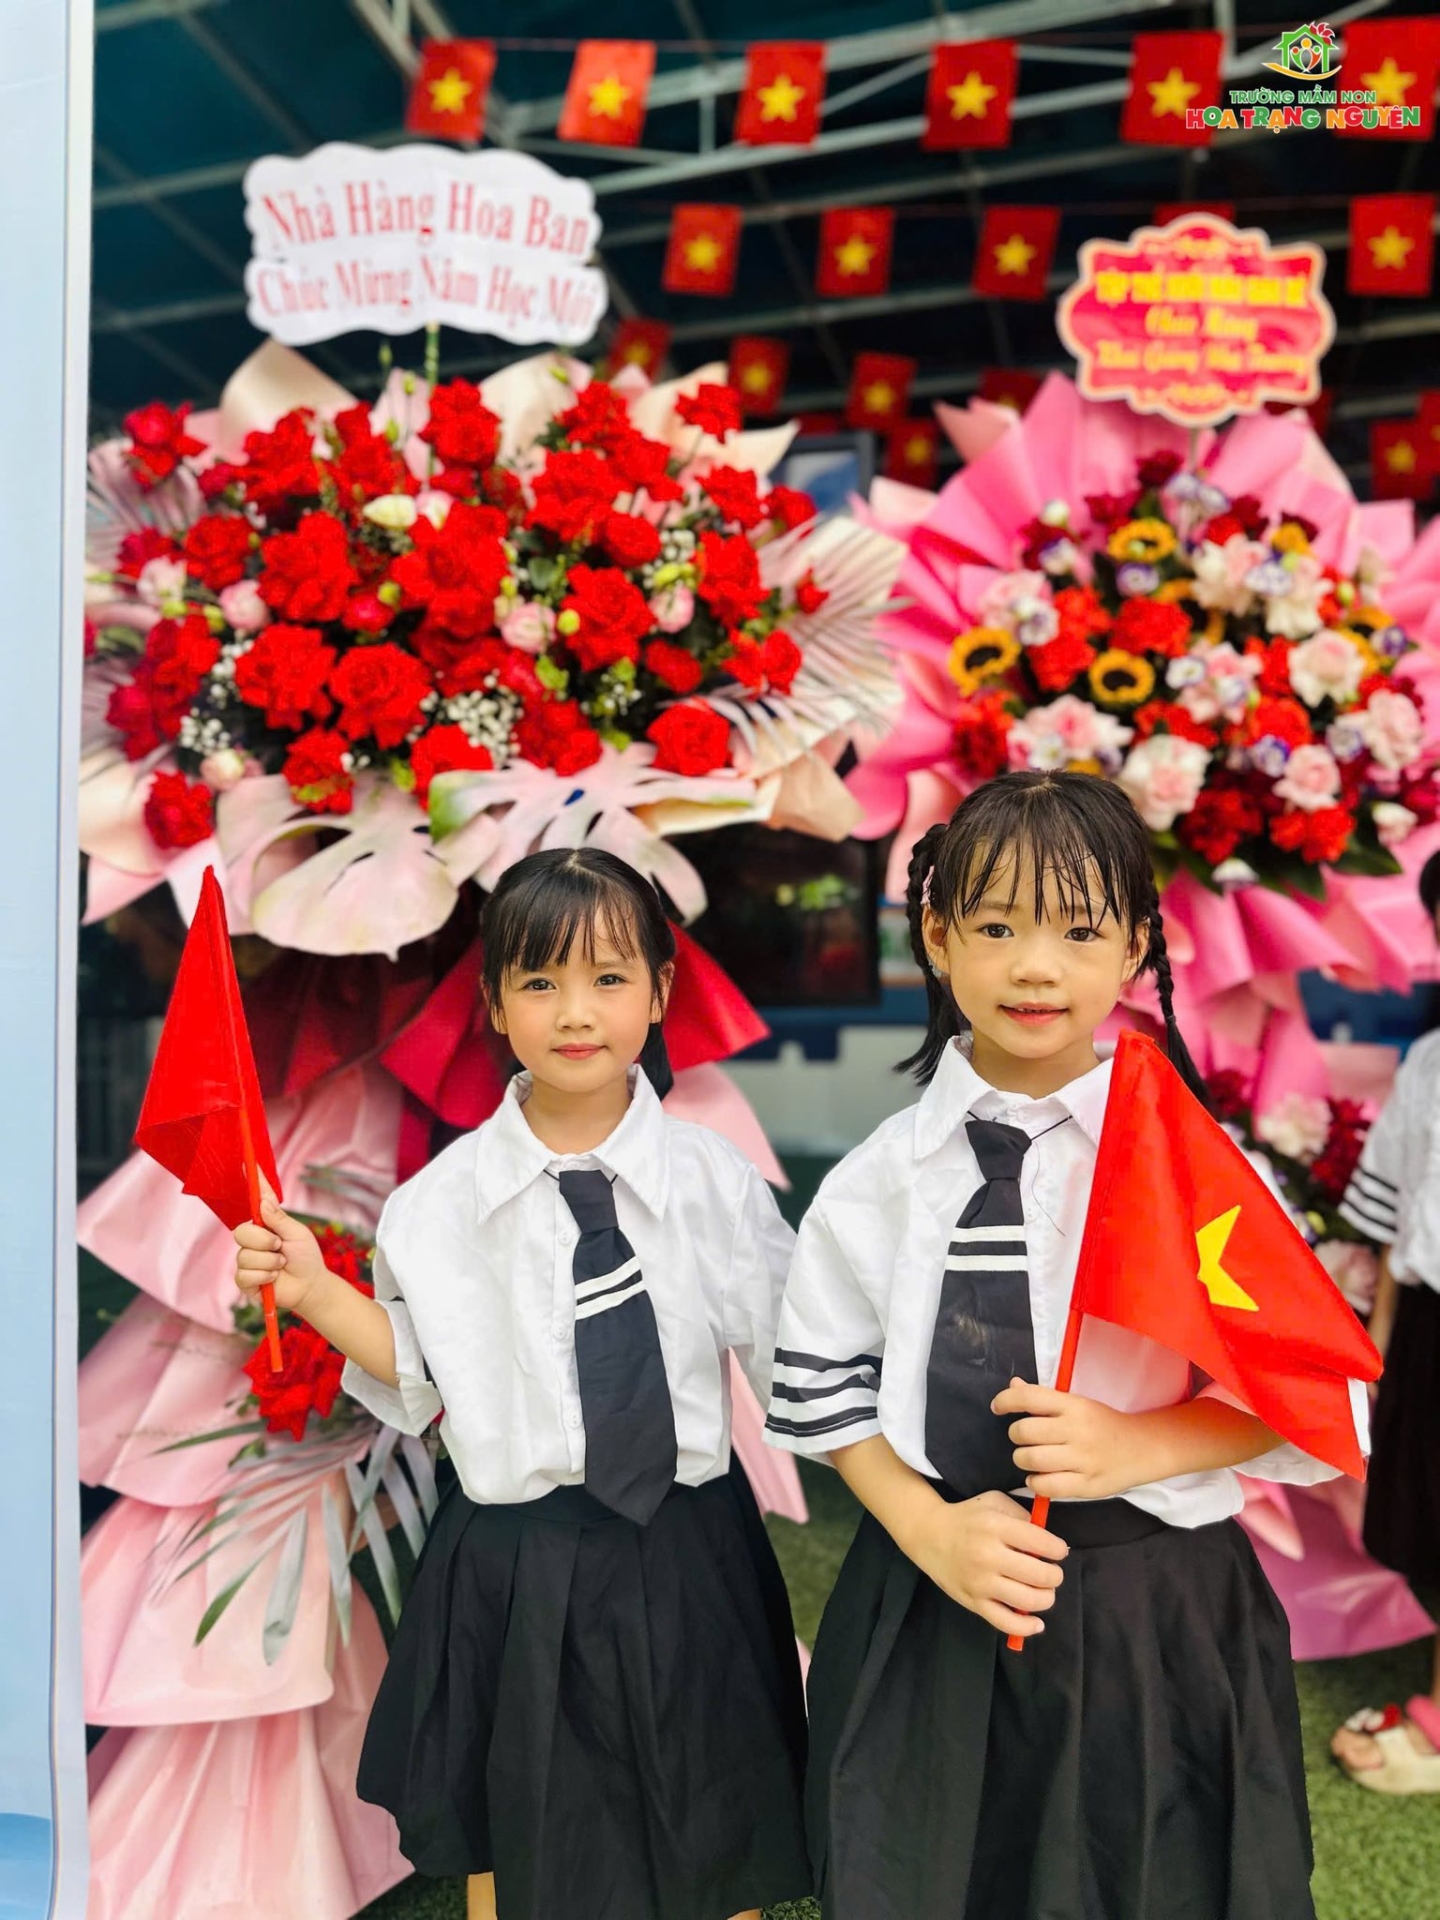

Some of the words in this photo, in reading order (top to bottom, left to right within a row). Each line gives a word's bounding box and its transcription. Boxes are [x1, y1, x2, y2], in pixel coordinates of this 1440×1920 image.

[261, 185, 336, 251] Nhà
[344, 179, 436, 247] Hàng
[447, 181, 516, 242] Hoa
[524, 195, 590, 256] Ban
[256, 266, 330, 317] Chúc
[486, 264, 538, 328] Học
